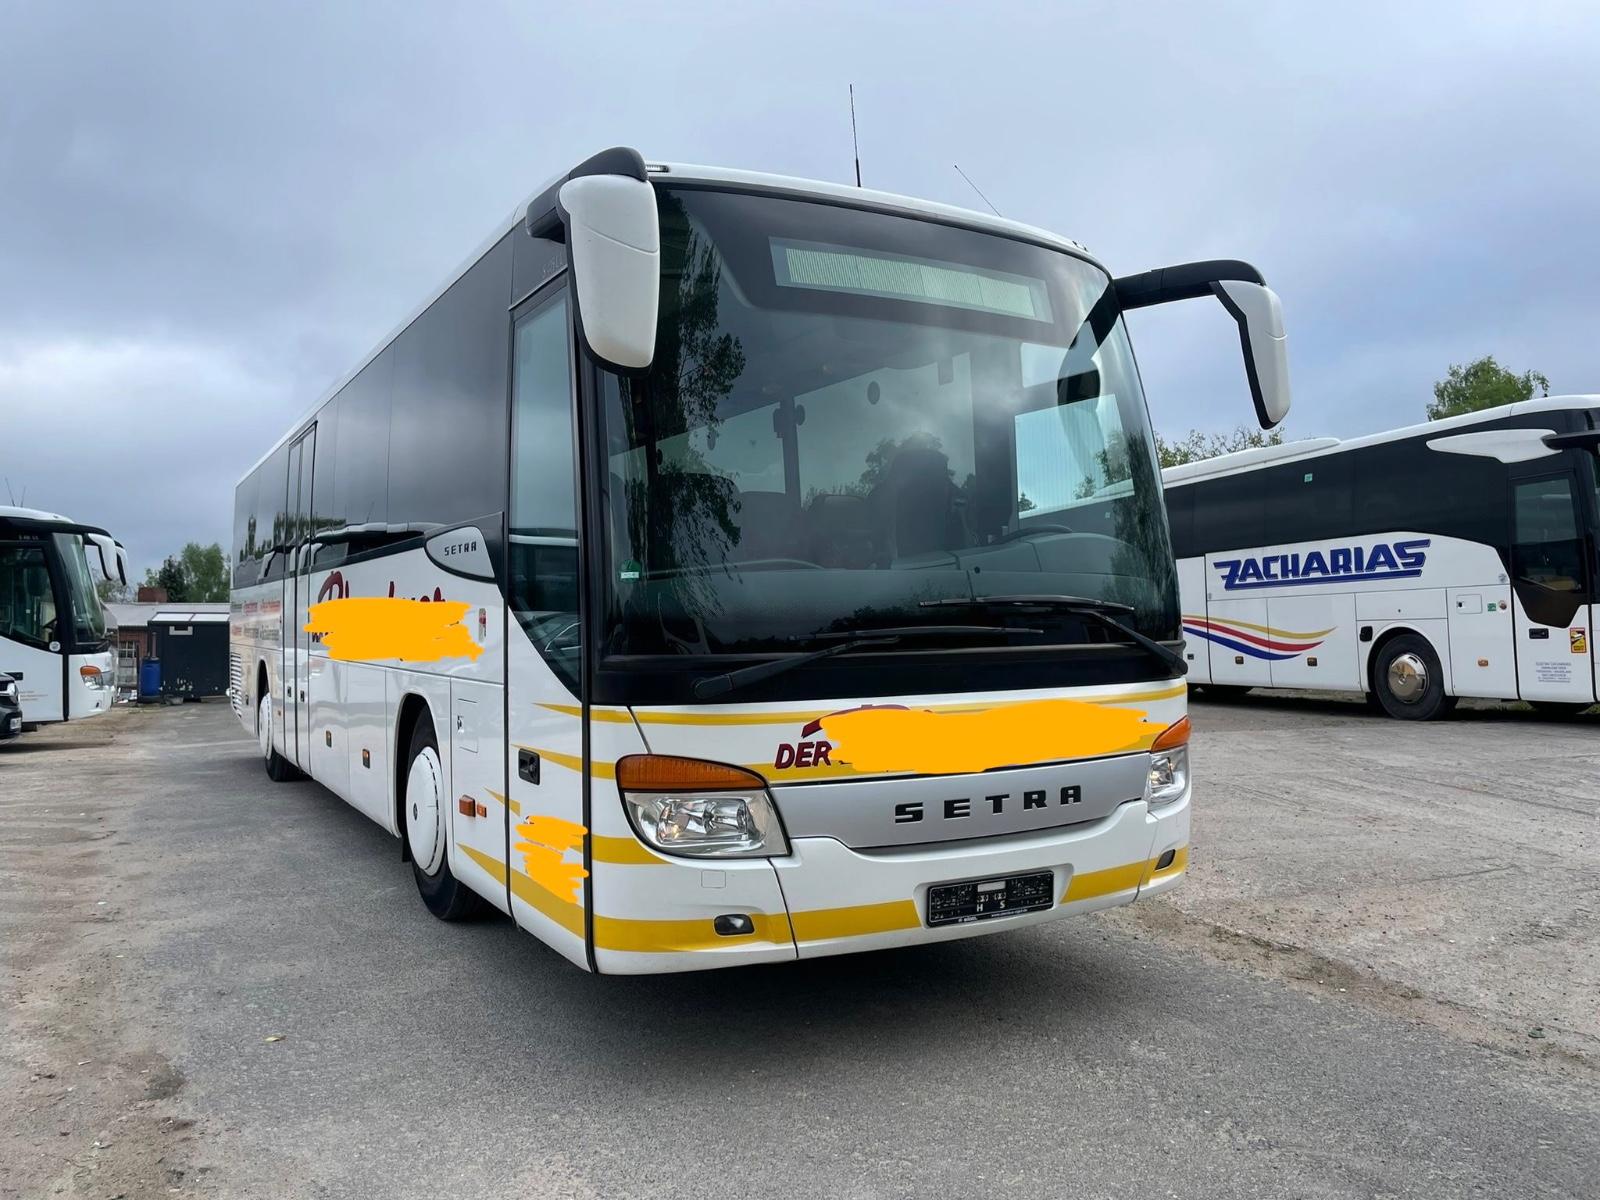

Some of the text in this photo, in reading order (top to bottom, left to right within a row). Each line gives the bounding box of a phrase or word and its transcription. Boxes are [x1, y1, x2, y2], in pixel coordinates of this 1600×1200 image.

[444, 541, 477, 556] SETRA
[1213, 538, 1431, 591] ZACHARIAS
[774, 740, 833, 769] DER
[895, 785, 1081, 823] SETRA
